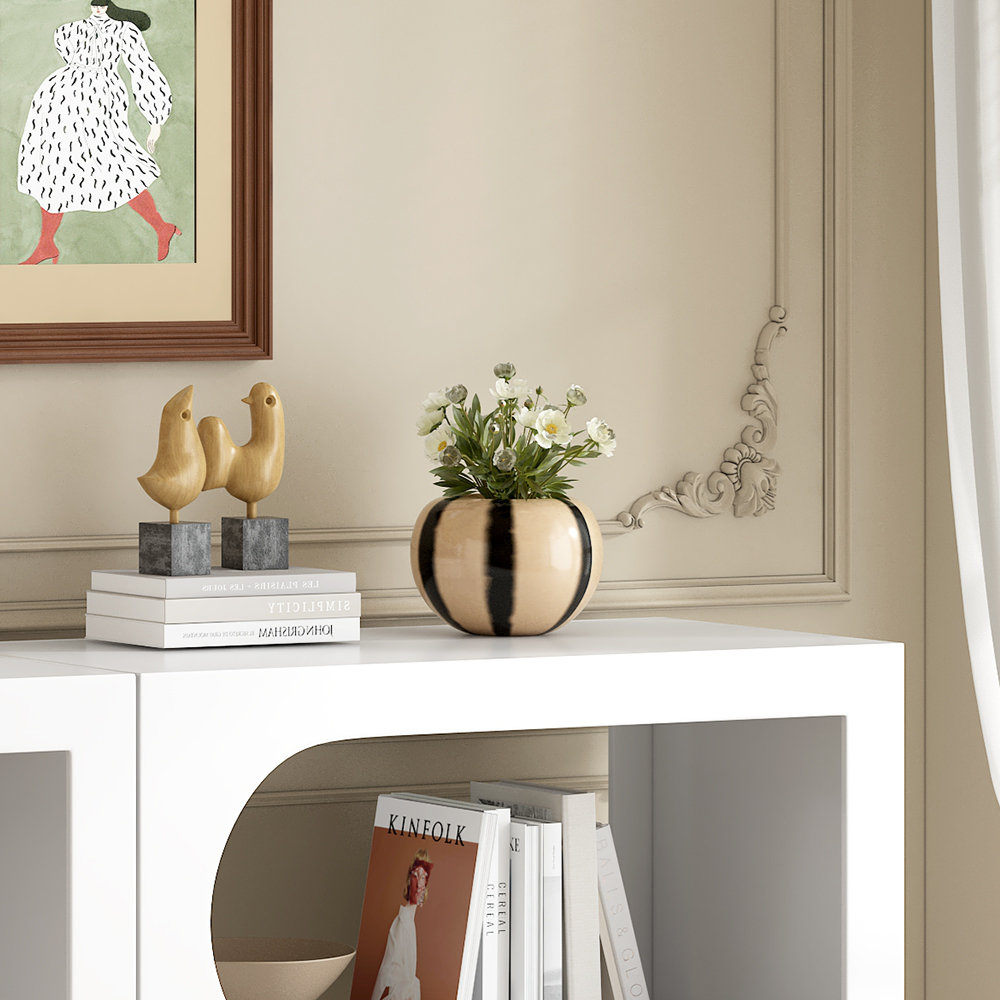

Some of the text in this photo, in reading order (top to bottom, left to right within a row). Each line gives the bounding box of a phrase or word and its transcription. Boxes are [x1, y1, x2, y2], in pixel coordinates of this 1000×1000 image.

[387, 813, 467, 847] KINFOLK
[486, 883, 495, 937] CEREAL
[497, 881, 507, 935] CEREAL
